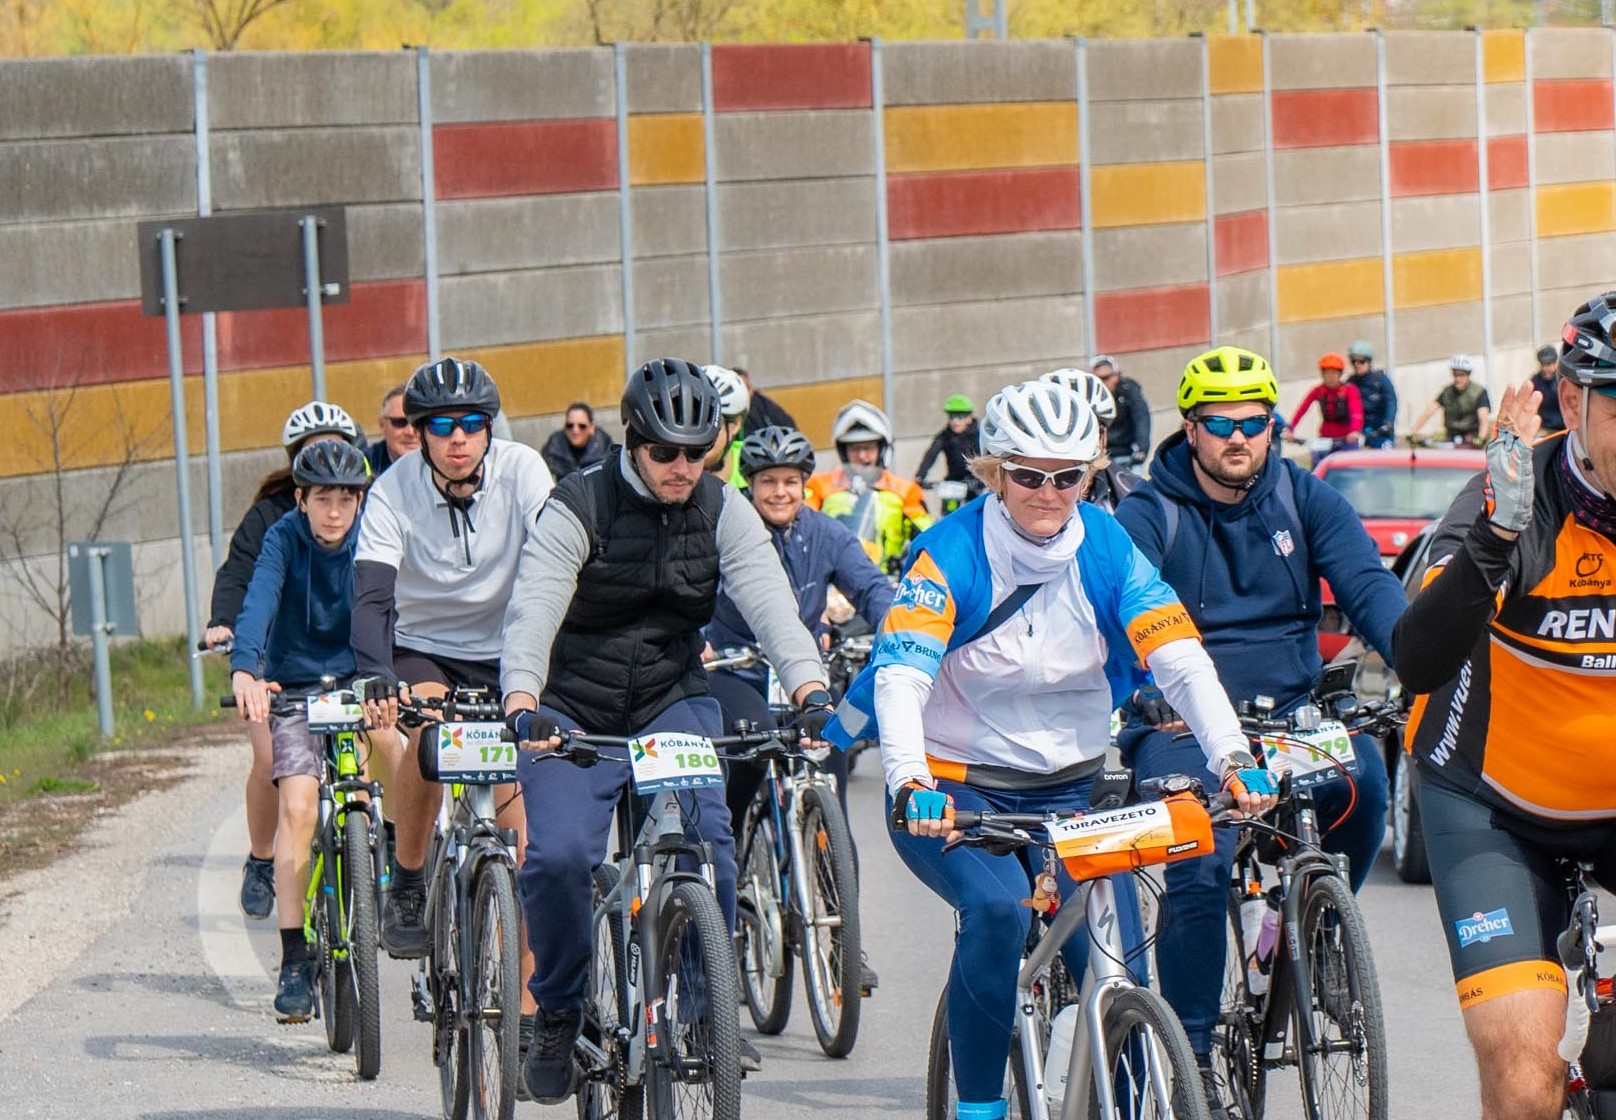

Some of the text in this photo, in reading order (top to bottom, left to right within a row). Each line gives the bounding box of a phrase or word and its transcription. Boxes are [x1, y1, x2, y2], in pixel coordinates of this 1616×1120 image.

[480, 746, 514, 763] 171
[1308, 736, 1349, 763] 179
[675, 753, 718, 769] 180
[1459, 917, 1510, 941] Dreher
